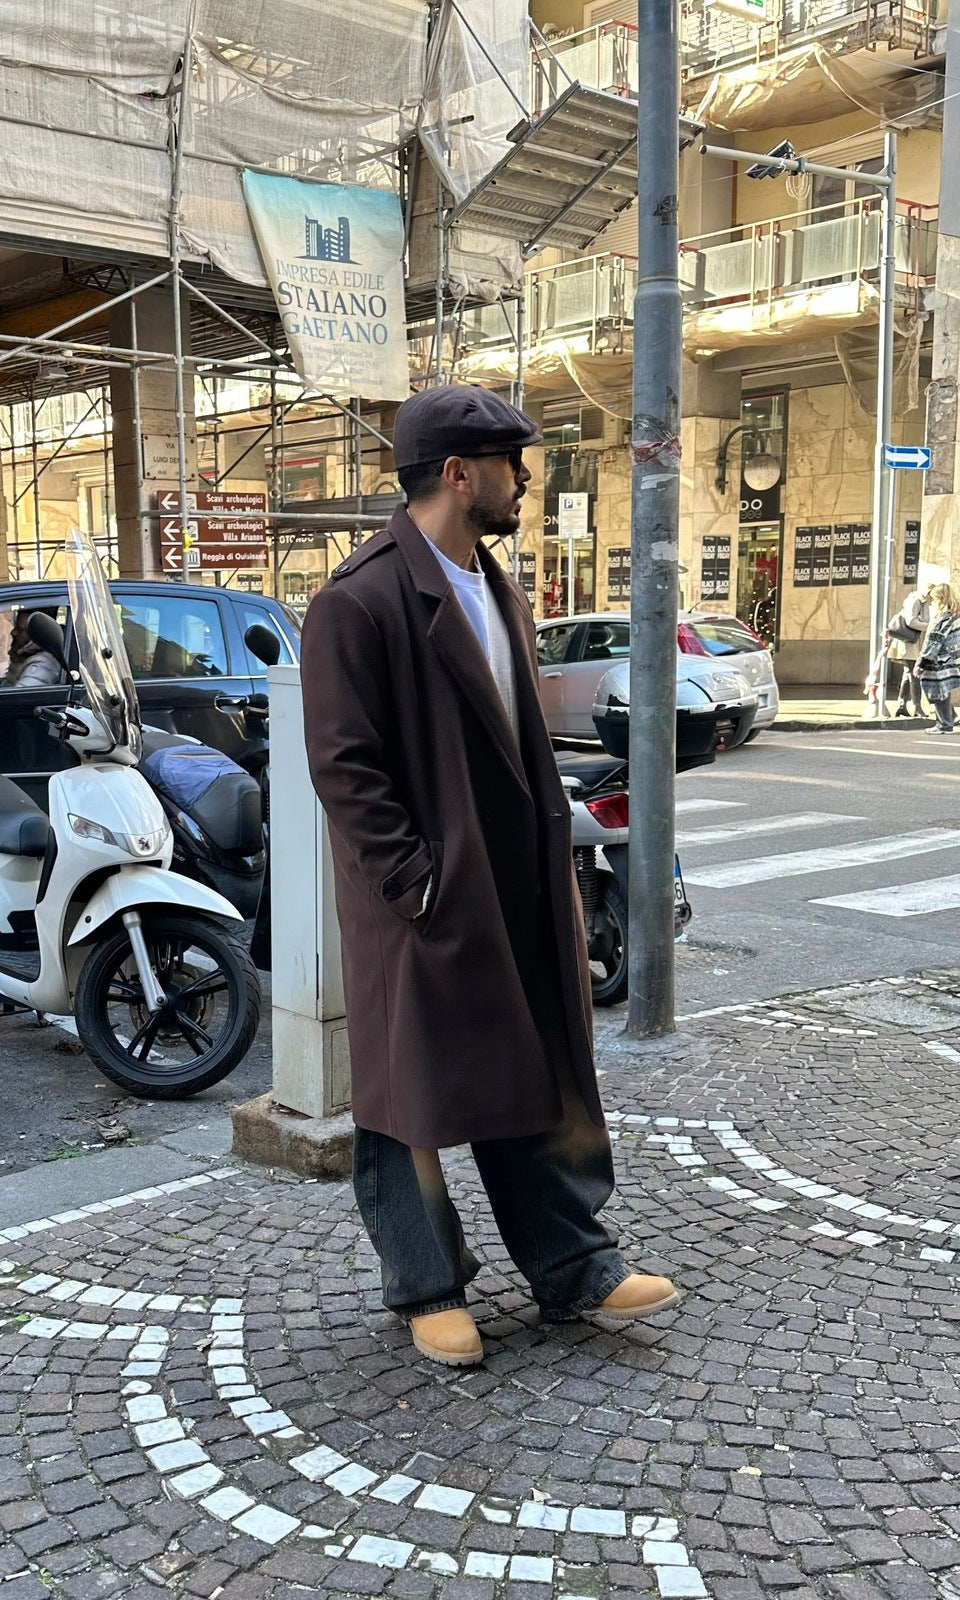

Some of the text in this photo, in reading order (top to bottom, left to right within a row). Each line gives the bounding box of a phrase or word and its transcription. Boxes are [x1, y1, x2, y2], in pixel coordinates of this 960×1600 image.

[276, 260, 384, 290] IMPRESA EDILE
[278, 281, 387, 318] STAIANO
[283, 311, 388, 345] GAETANO
[206, 494, 263, 505] Scavi archeologici
[208, 521, 263, 531] Scavi archeologici
[241, 533, 263, 541] Arianna
[272, 534, 314, 544] OTONDO
[202, 553, 225, 561] Reggia
[286, 594, 308, 604] BLACK
